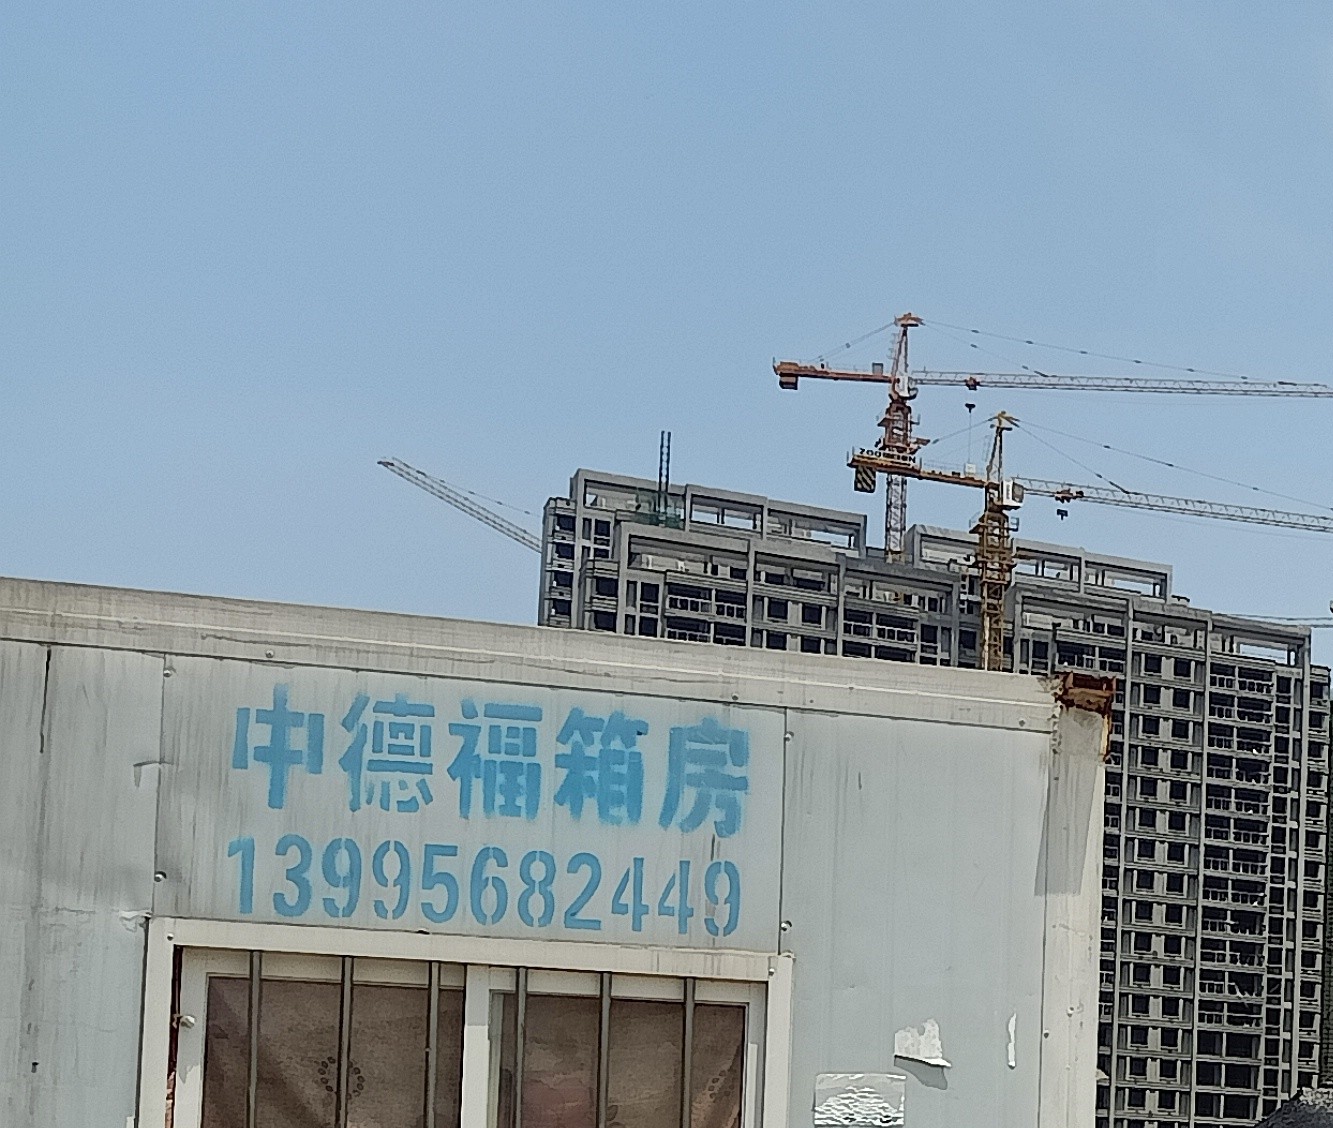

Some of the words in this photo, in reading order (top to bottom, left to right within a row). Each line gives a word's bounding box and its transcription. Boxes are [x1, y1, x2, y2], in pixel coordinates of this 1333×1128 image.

[231, 682, 751, 838] 中德福箱房
[227, 833, 743, 938] 13995682449
